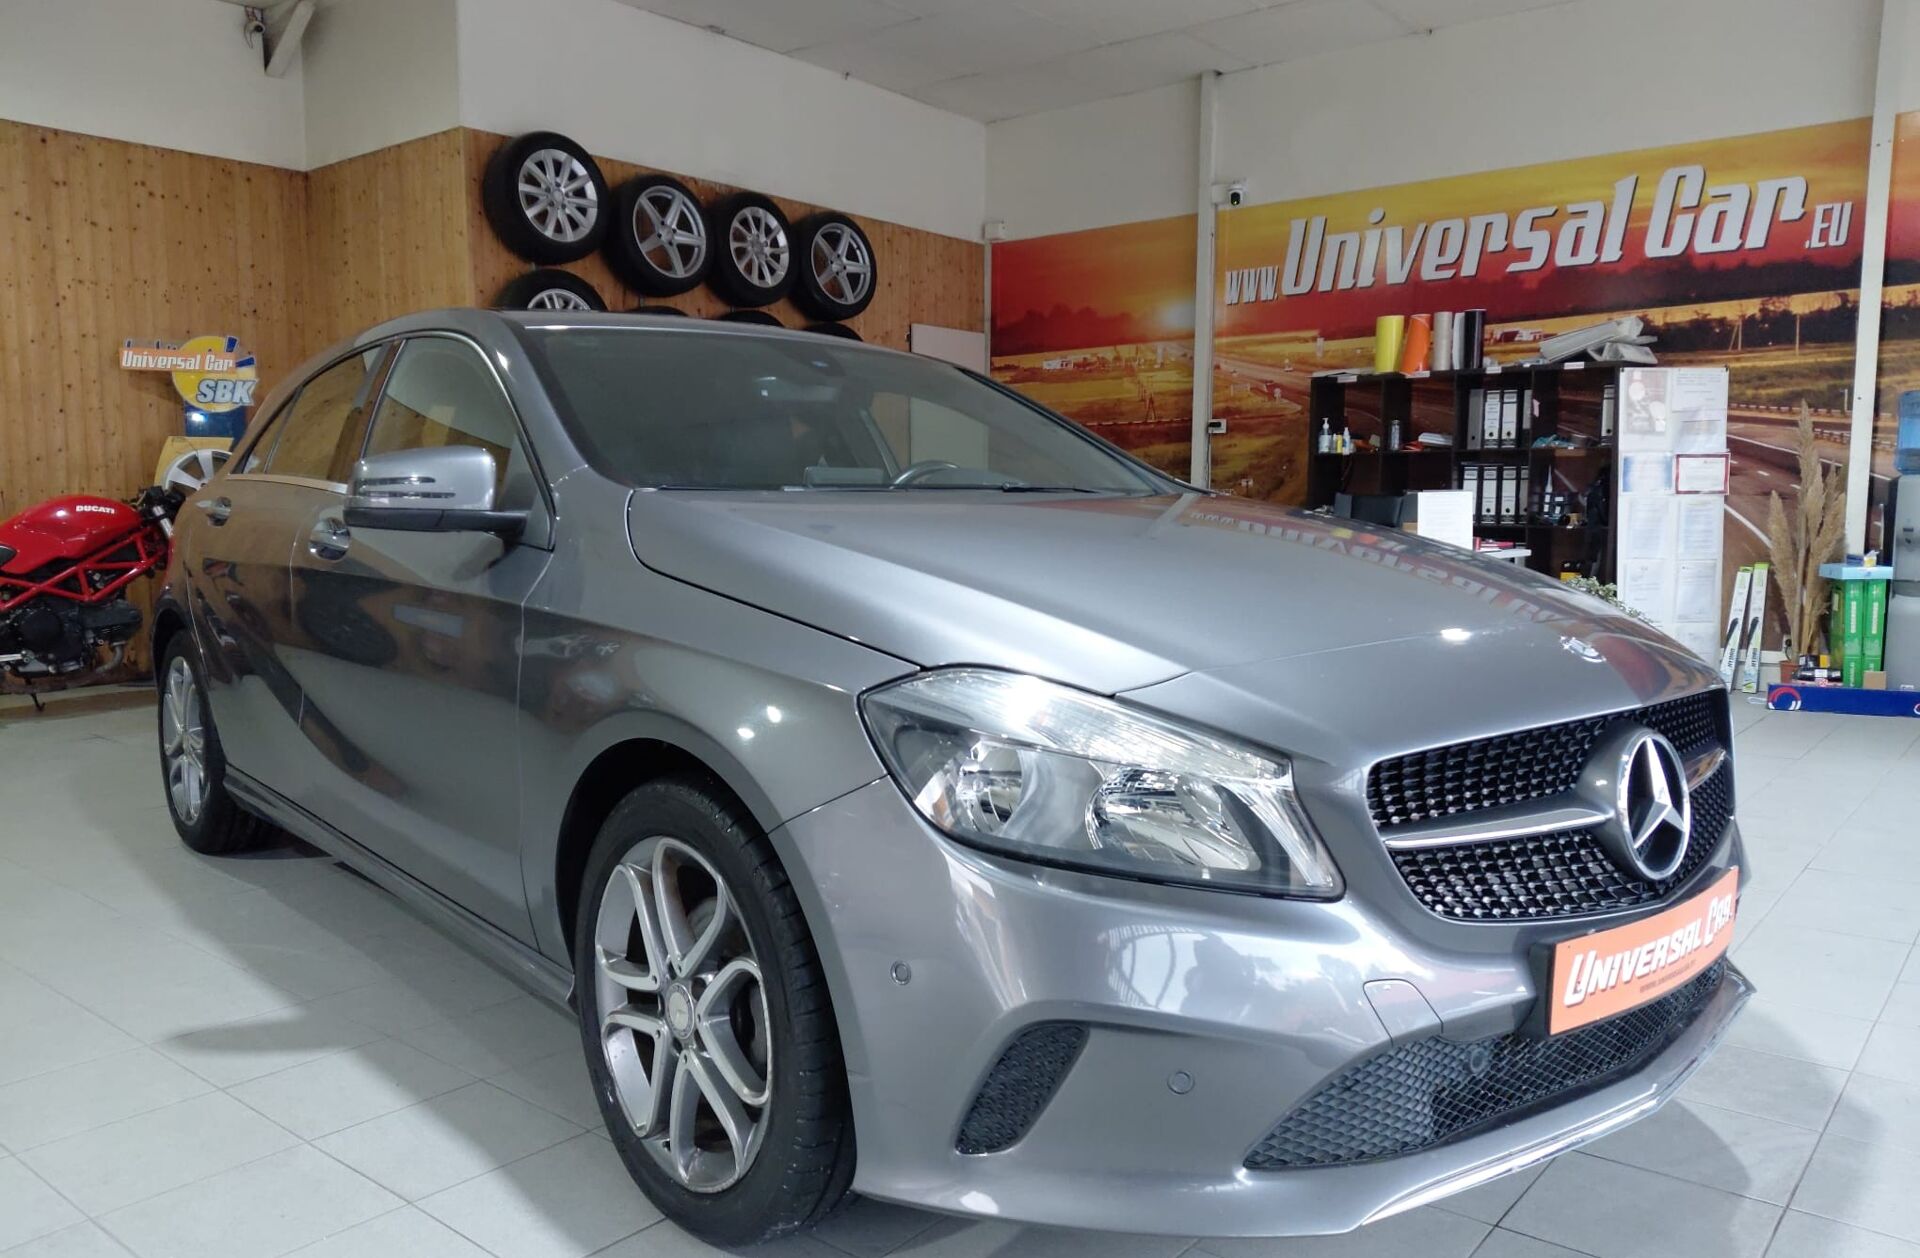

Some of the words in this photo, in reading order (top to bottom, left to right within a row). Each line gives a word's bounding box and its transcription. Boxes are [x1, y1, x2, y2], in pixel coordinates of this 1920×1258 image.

[122, 350, 201, 370] Universal
[204, 354, 234, 371] Car
[196, 379, 257, 405] SBK
[75, 504, 115, 515] DUCATI
